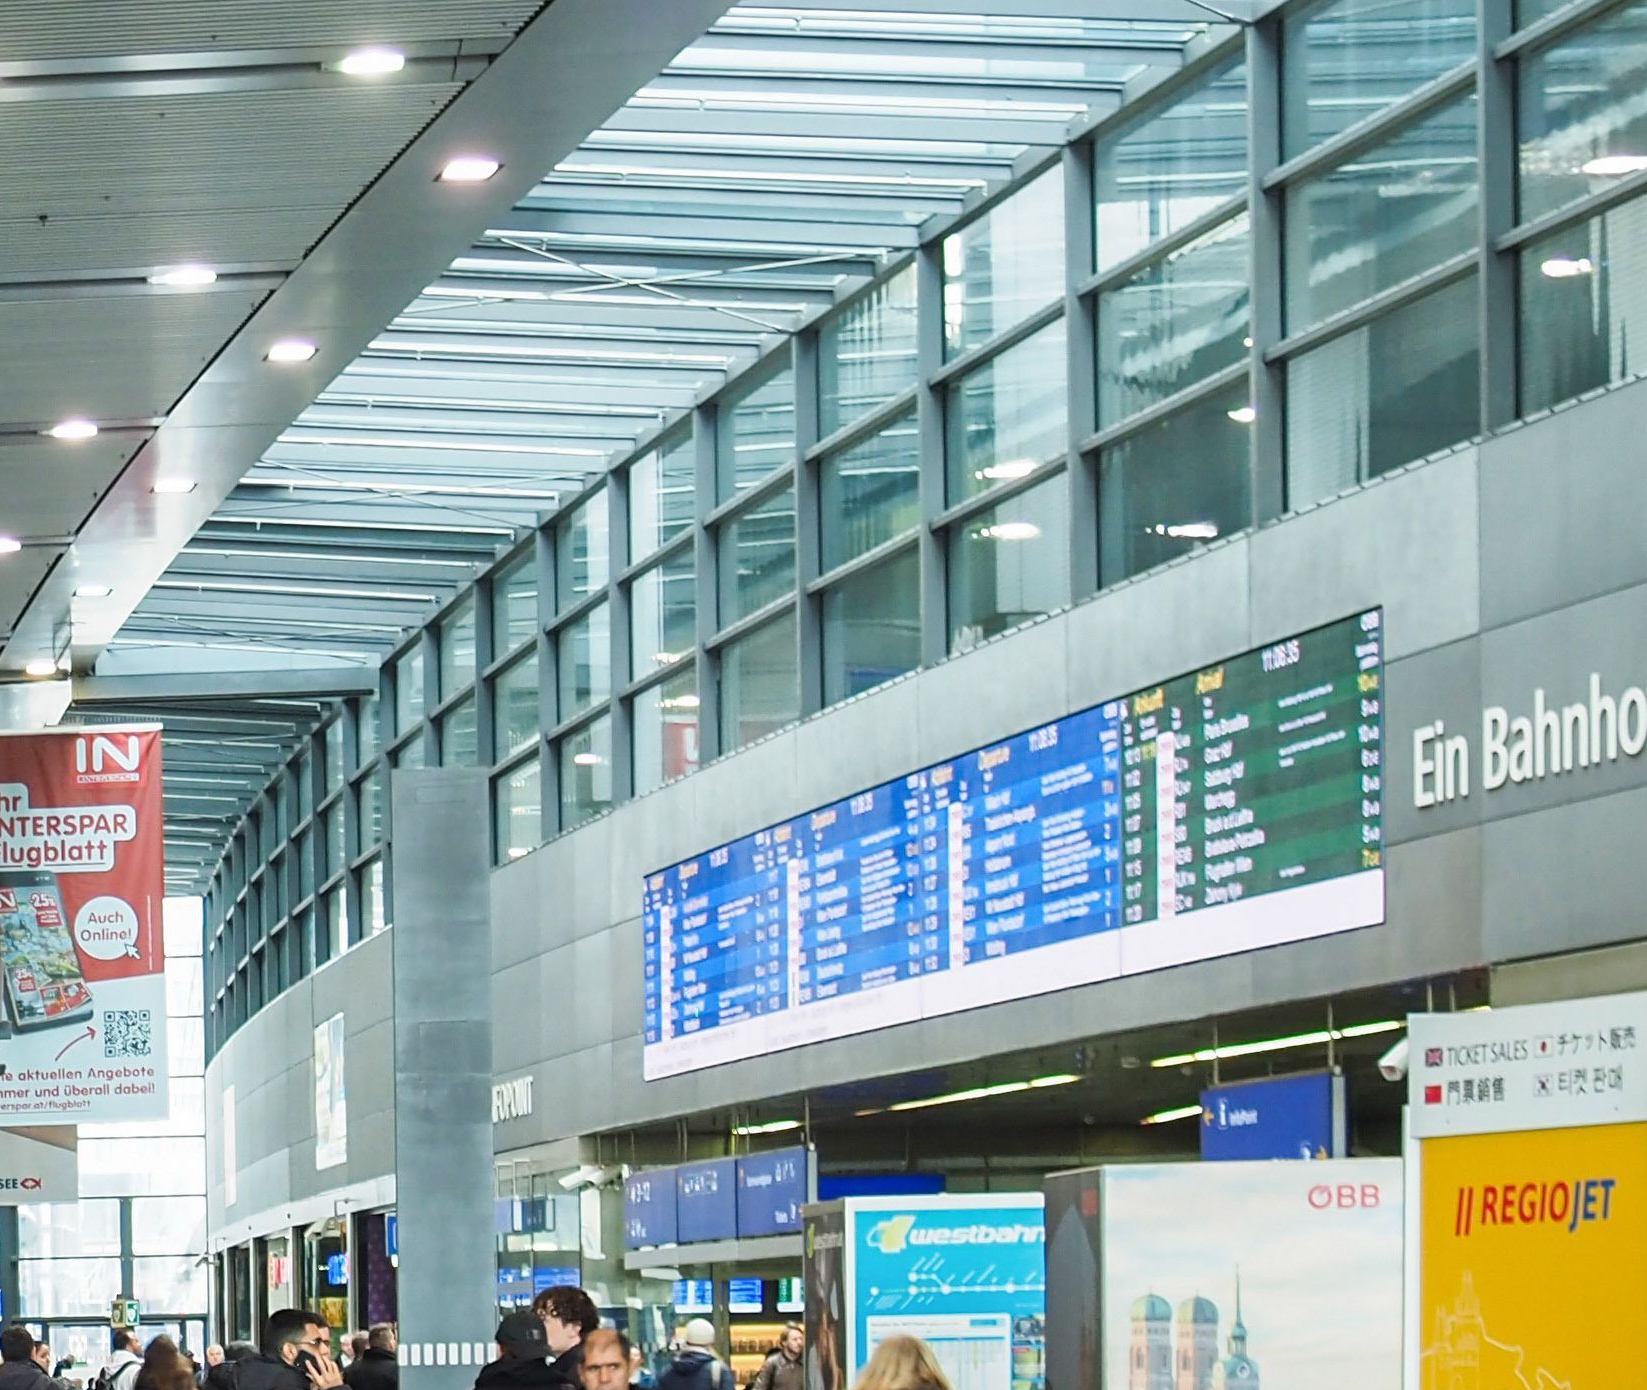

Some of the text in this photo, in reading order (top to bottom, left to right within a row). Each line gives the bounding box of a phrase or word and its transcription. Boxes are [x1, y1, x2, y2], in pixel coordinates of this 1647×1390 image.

[1413, 719, 1469, 808] Ein
[1482, 672, 1647, 790] Bahnho
[76, 735, 140, 773] IN
[88, 911, 123, 924] Auch
[81, 928, 132, 943] Online!
[1447, 1040, 1528, 1066] TICKET SALES
[18, 1068, 83, 1081] aktuellen
[87, 1066, 155, 1081] Angebote
[35, 1085, 59, 1097] und
[64, 1083, 109, 1096] überall
[115, 1083, 156, 1095] dabei!
[1481, 1178, 1616, 1234] REGIOJET
